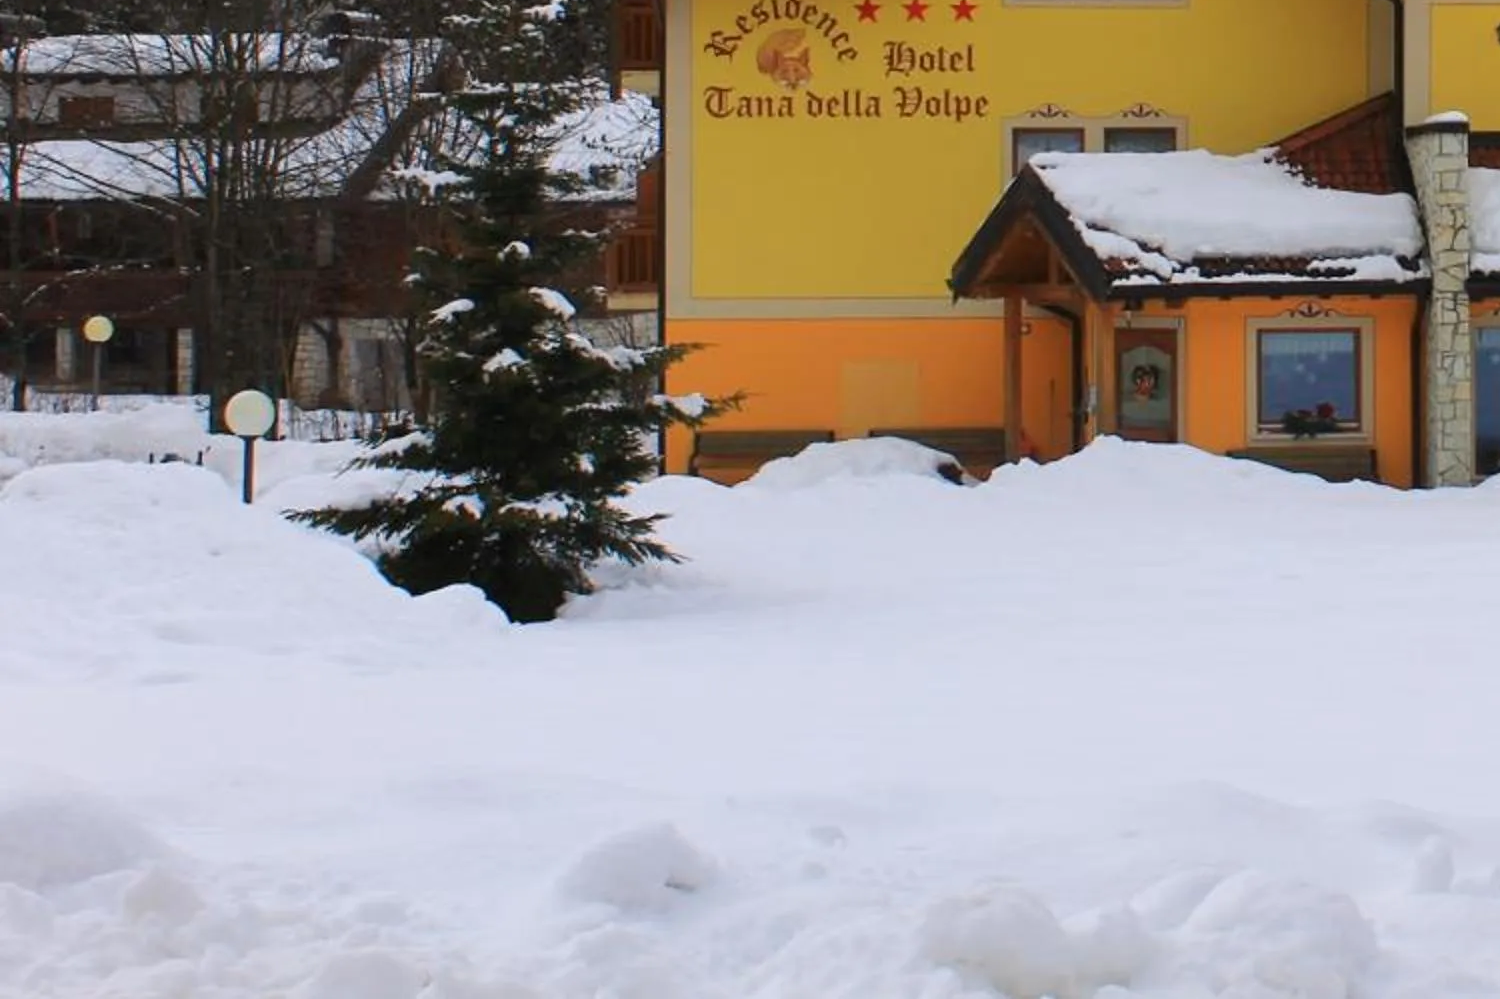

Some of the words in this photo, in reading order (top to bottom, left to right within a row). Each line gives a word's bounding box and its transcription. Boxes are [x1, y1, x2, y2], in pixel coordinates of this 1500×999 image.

[883, 41, 975, 77] Hotel
[703, 85, 795, 119] Tana
[806, 89, 881, 119] della
[893, 86, 989, 122] Volpe
